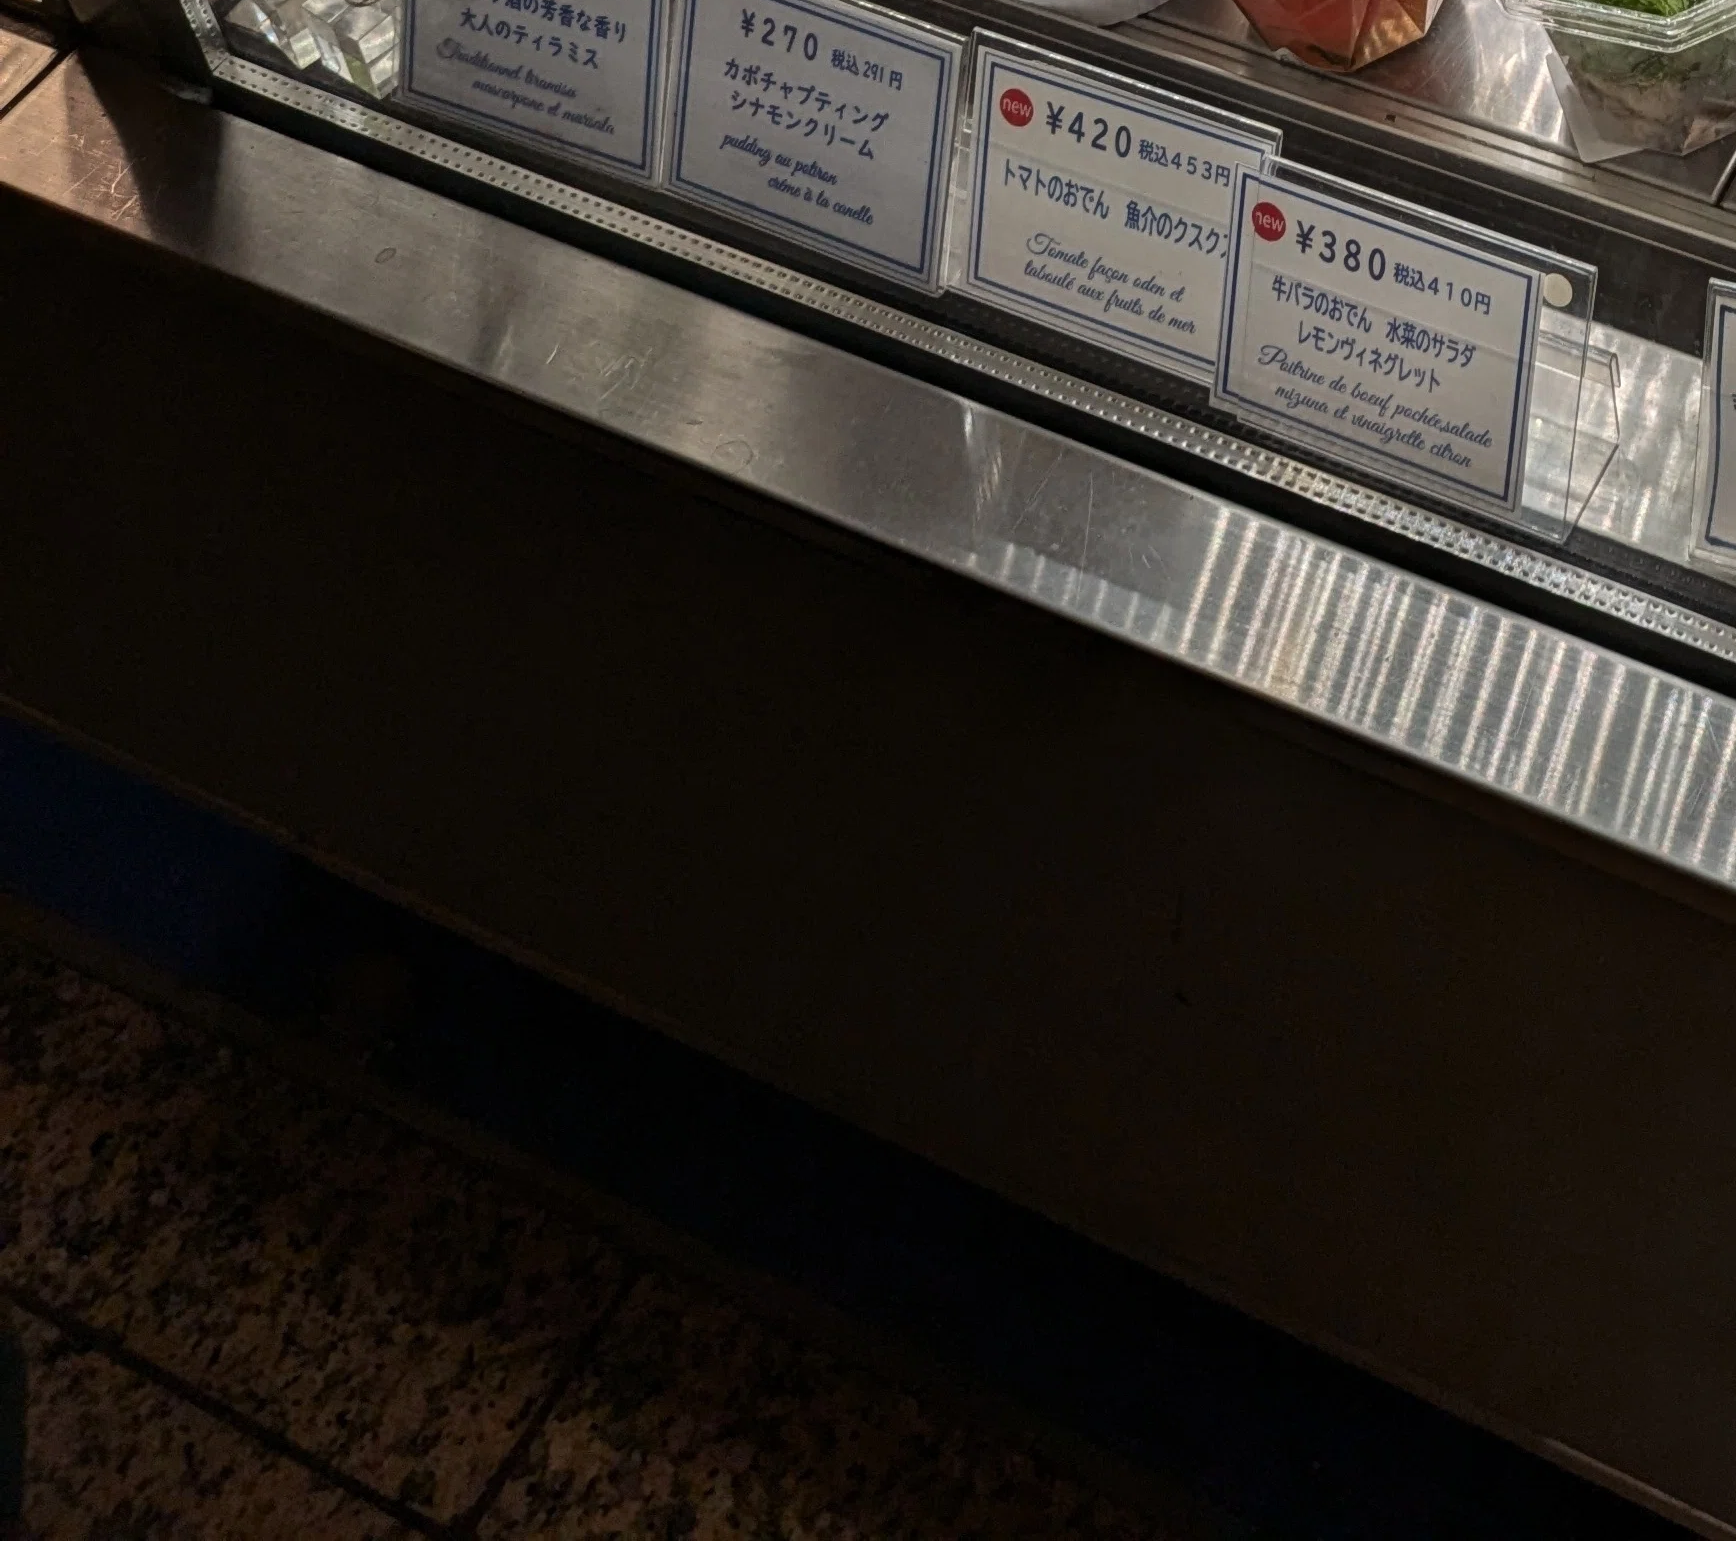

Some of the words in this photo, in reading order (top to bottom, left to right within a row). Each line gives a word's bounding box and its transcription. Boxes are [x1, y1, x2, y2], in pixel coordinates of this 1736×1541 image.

[460, 8, 598, 68] 大人のティラミス
[740, 9, 818, 61] ¥270
[719, 134, 772, 167] pudding
[775, 154, 792, 167] au
[731, 91, 875, 160] シナモンクリーム
[1002, 97, 1032, 118] new
[1046, 101, 1132, 158] ¥420
[816, 190, 830, 208] la
[1026, 232, 1089, 269] Tomate
[1088, 256, 1129, 285] façon
[1133, 276, 1165, 297] oden
[1169, 287, 1186, 303] et
[1256, 211, 1285, 233] new
[1295, 219, 1386, 281] ¥380
[1024, 260, 1075, 291] taboulé
[1078, 283, 1105, 302] aux
[1104, 288, 1145, 316] fruits
[1148, 305, 1166, 325] de
[1169, 315, 1197, 335] mer
[1257, 344, 1326, 386] Poitrine
[1329, 375, 1346, 393] de
[1351, 382, 1394, 417] boeuf
[1298, 321, 1441, 394] レモンヴィネグレット
[1274, 385, 1329, 413] mizuna
[1333, 405, 1350, 419] et
[1352, 412, 1426, 451] vinaigrette
[1430, 443, 1472, 468] citron
